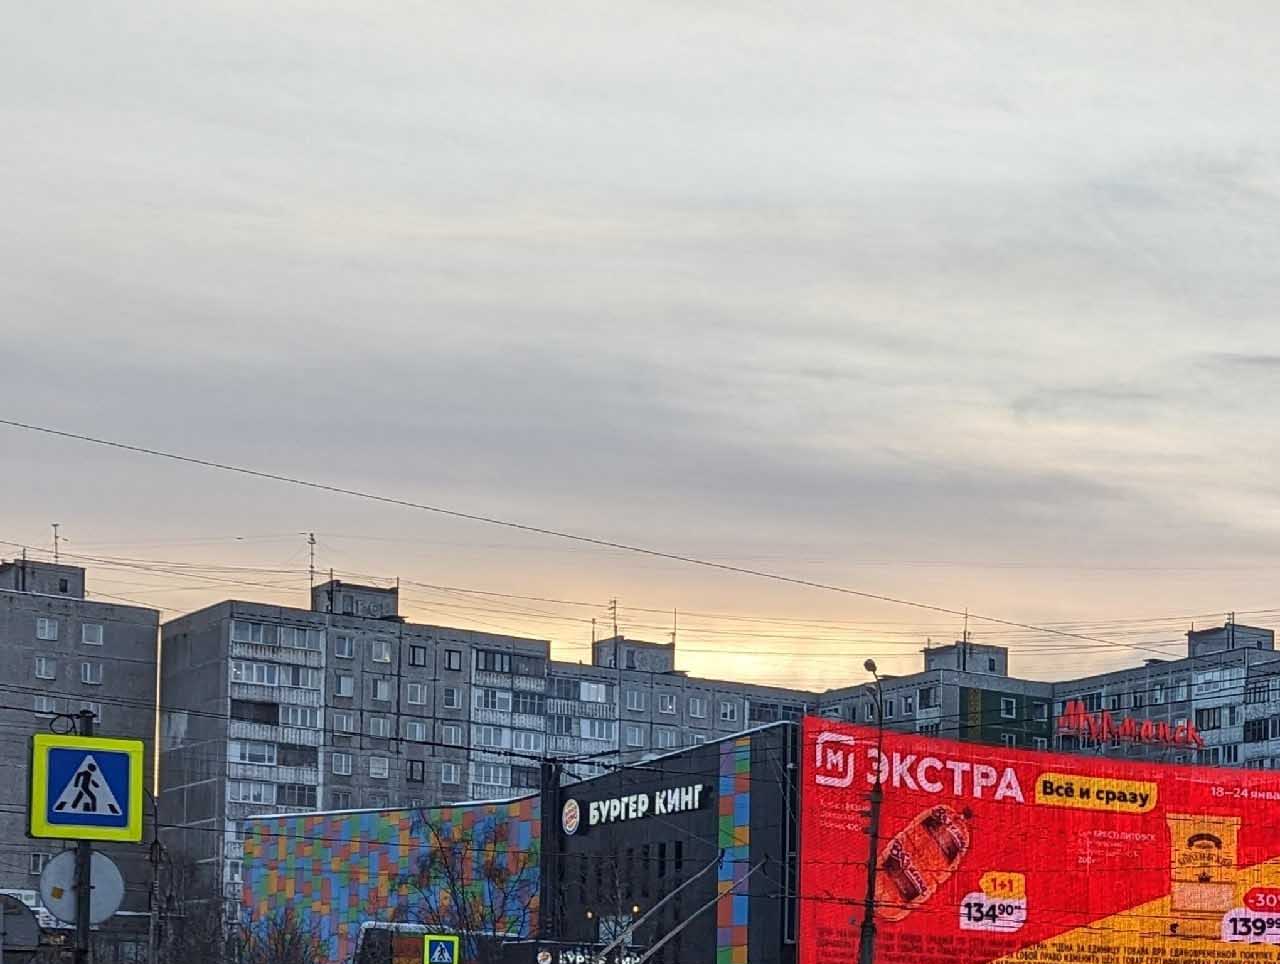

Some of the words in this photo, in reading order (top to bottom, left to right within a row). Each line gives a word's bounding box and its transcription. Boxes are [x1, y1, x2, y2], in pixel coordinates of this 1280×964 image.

[866, 748, 1025, 804] ЭКСТРА
[1041, 779, 1075, 799] Всё
[1079, 786, 1091, 798] и
[1095, 789, 1150, 808] сразу
[588, 794, 649, 826] БУРГЕР
[654, 783, 704, 815] КИНГ
[990, 877, 1014, 891] 1+1
